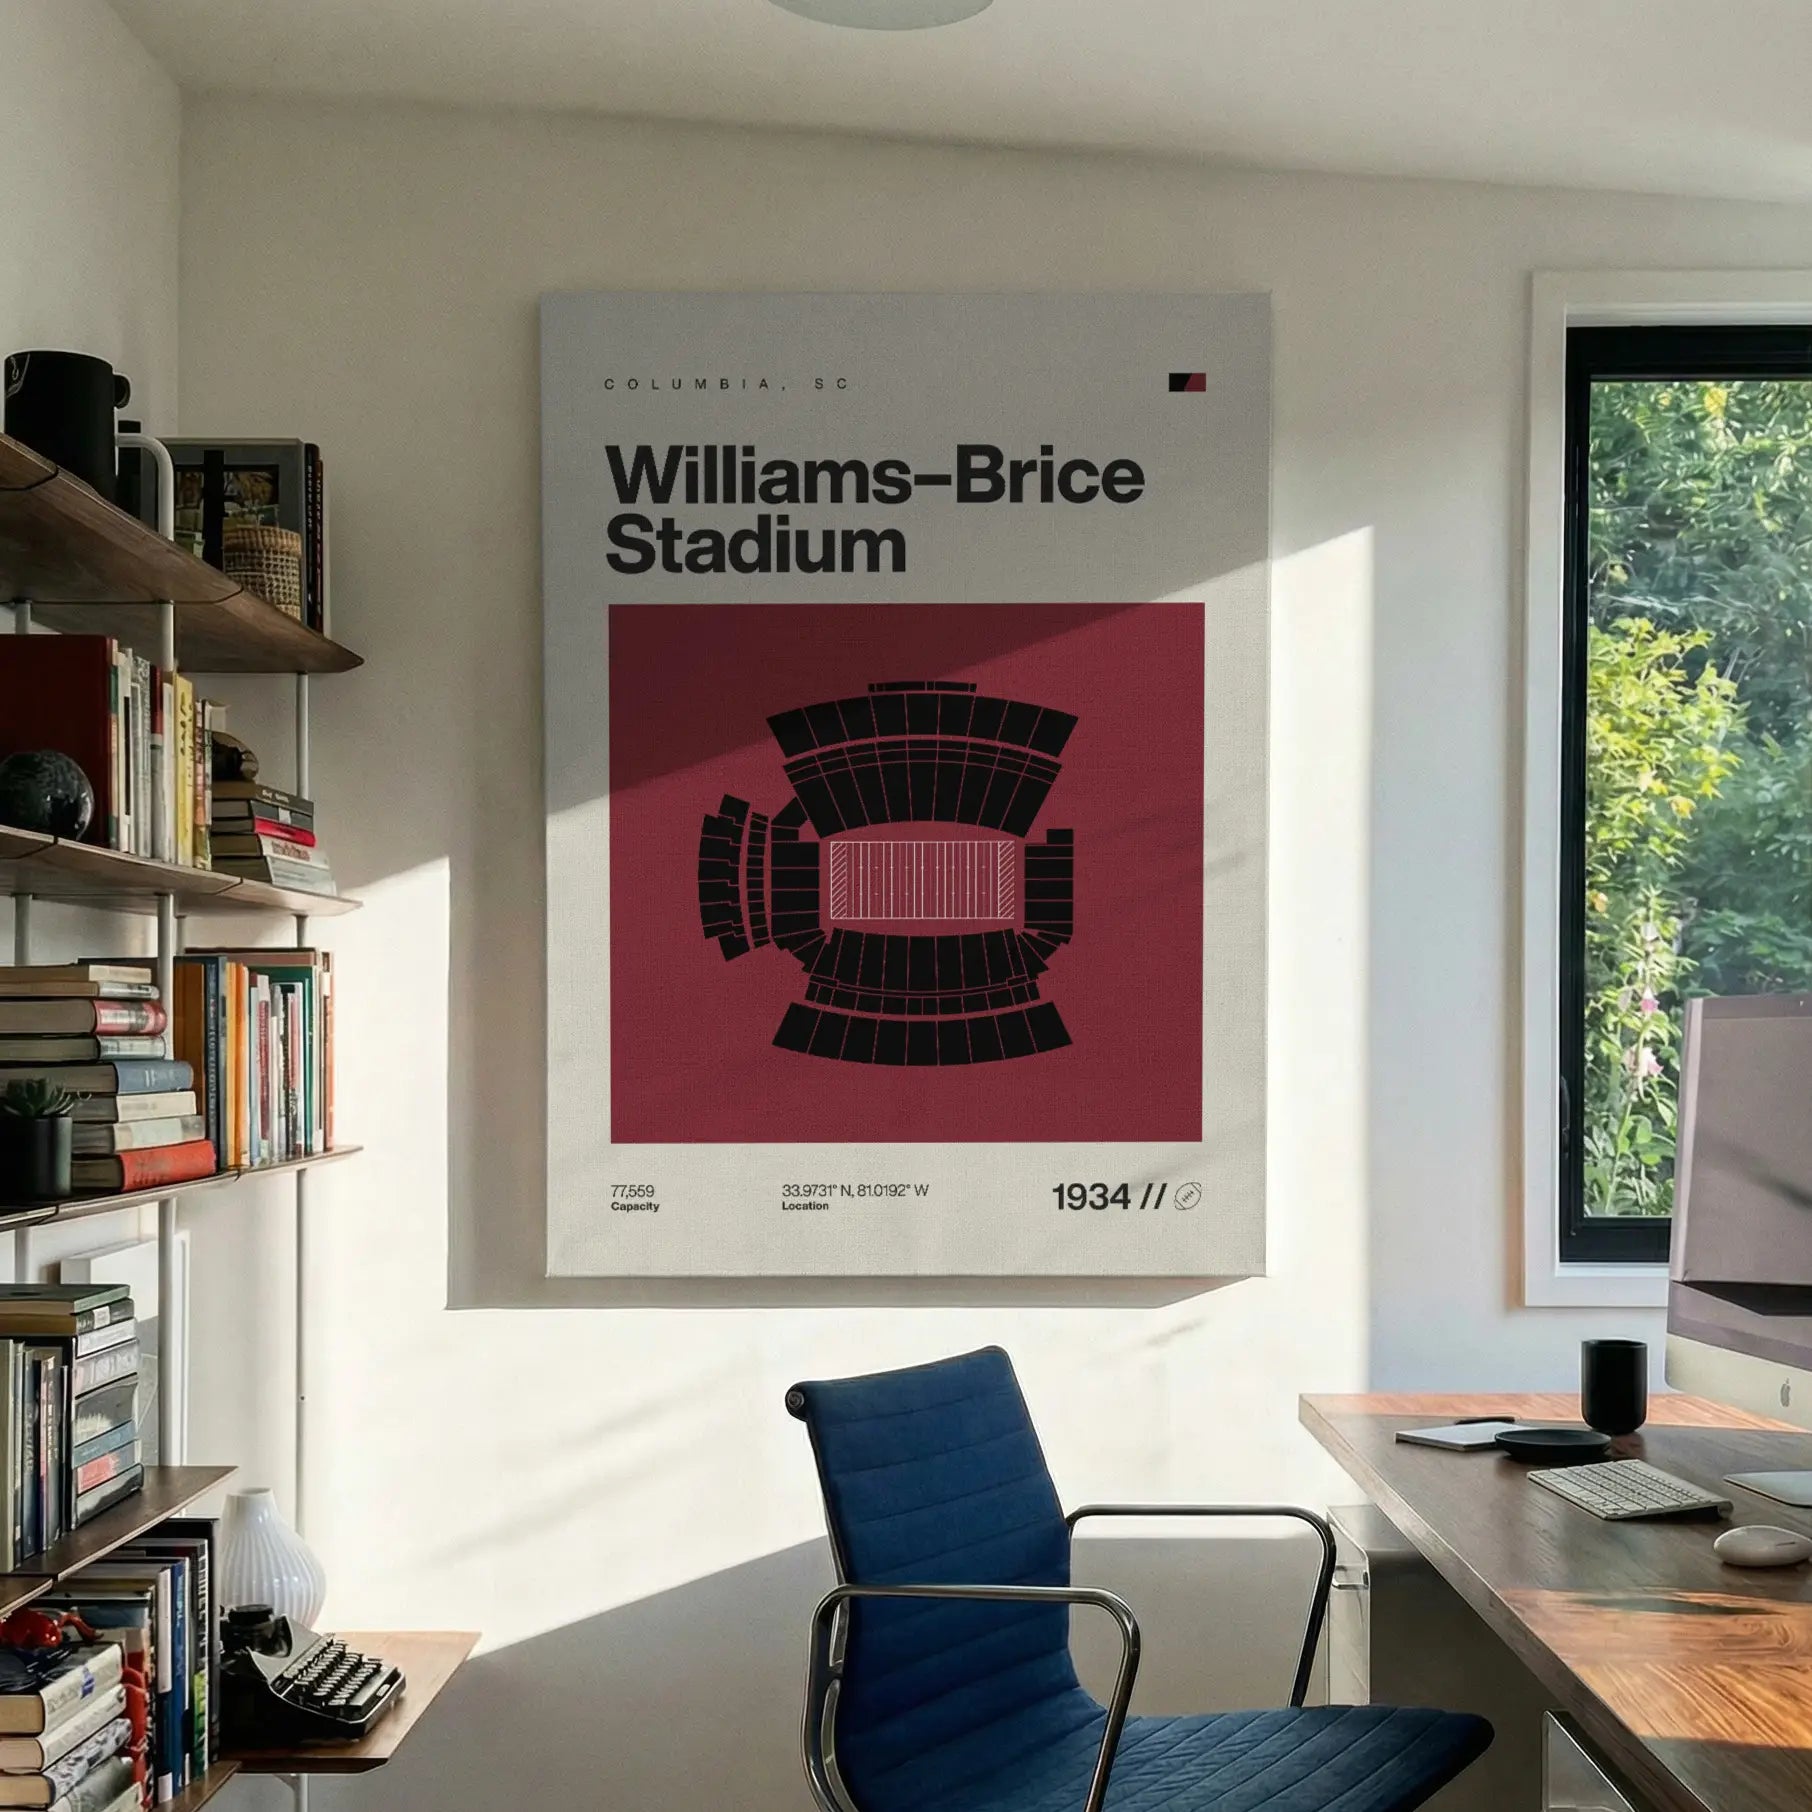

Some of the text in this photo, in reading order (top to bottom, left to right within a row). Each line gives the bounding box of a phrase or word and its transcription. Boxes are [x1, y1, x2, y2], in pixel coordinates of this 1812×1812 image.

[604, 378, 847, 391] COLUMBIA, SC
[606, 513, 906, 574] Stadium
[611, 1184, 655, 1199] 77,559
[840, 1184, 855, 1198] N,
[914, 1184, 930, 1197] W
[1053, 1182, 1132, 1211] 1934
[610, 1201, 660, 1213] Capacity
[782, 1201, 829, 1211] Location
